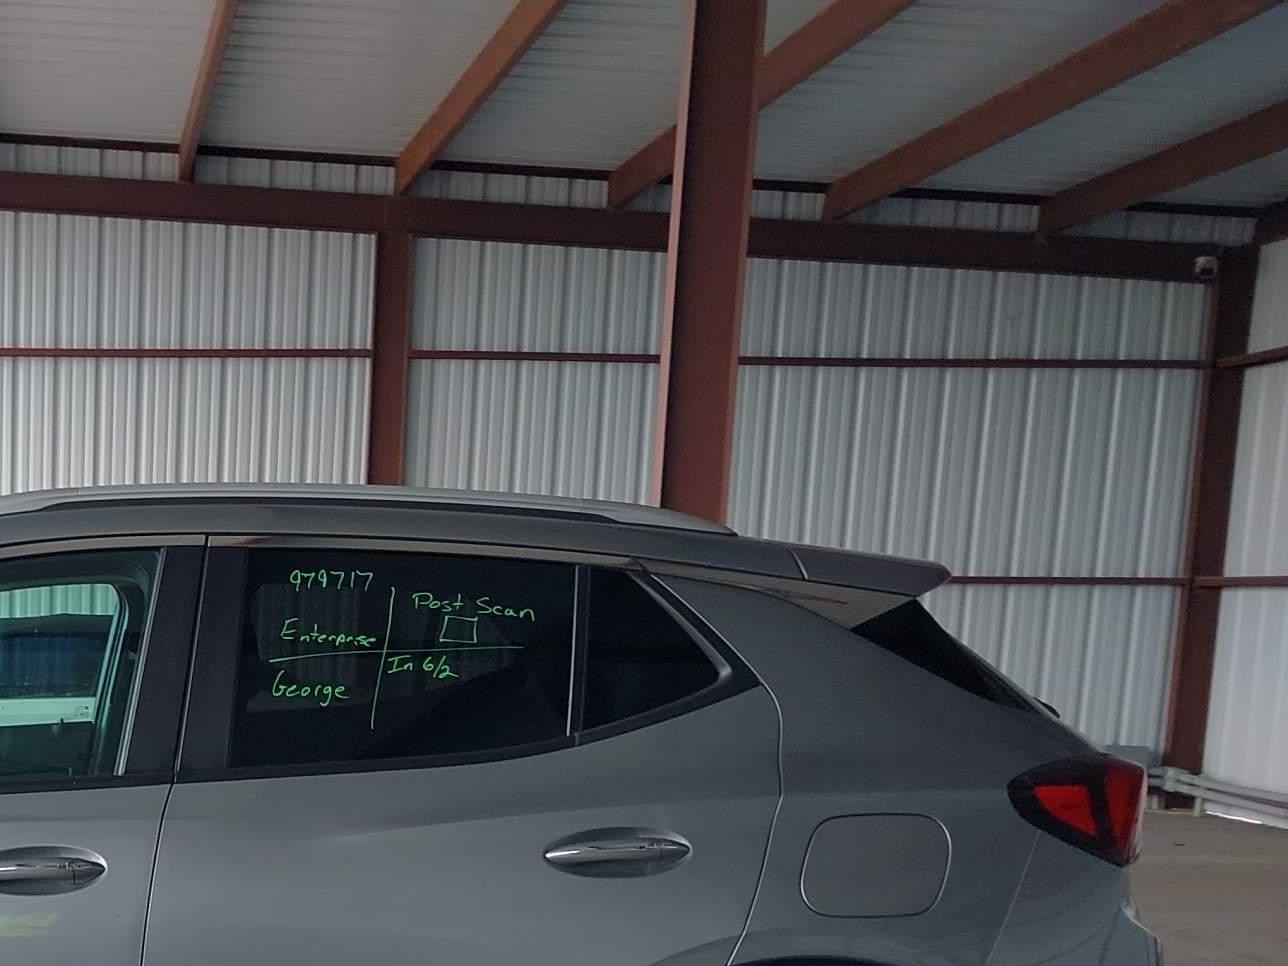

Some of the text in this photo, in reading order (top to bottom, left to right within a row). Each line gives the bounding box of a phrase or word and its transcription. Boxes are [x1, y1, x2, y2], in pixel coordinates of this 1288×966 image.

[289, 569, 374, 592] 979717
[412, 592, 536, 622] Post Scan
[280, 617, 377, 647] Enterprise
[387, 655, 460, 680] In 6/2
[272, 670, 352, 707] George
